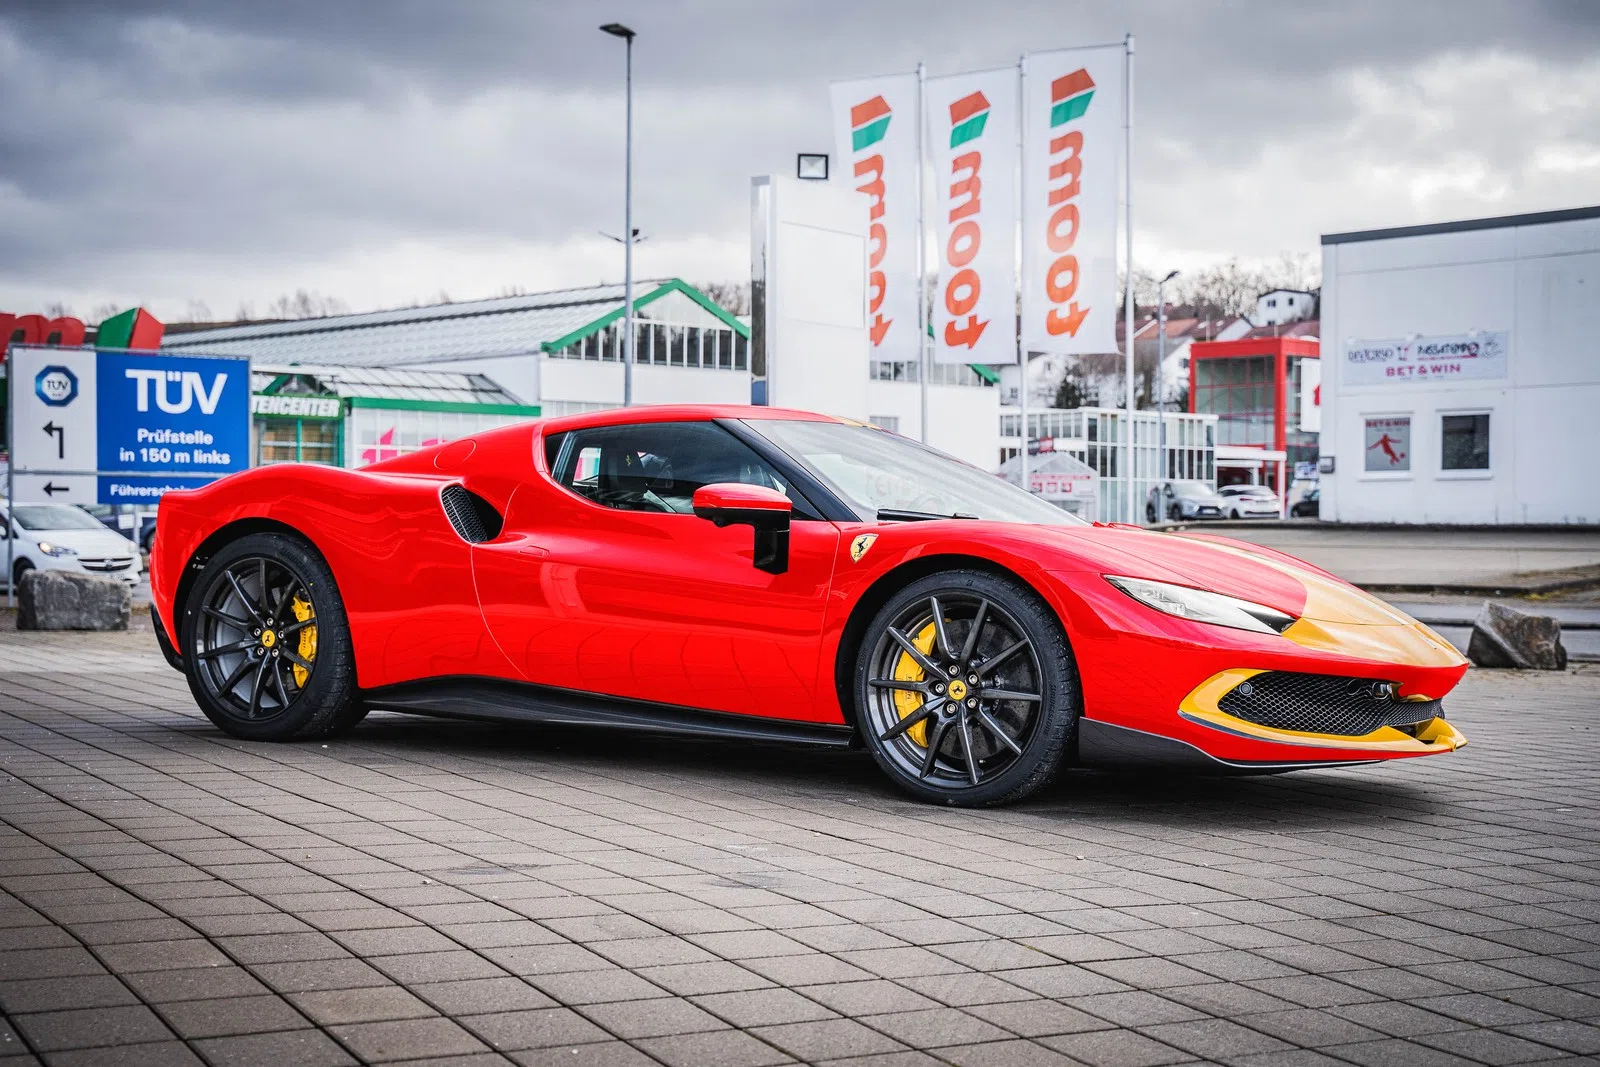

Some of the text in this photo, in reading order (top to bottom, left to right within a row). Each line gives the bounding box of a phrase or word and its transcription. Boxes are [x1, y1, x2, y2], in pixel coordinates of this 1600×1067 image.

[944, 150, 990, 349] toom
[1045, 130, 1090, 338] toom
[125, 368, 228, 415] TÜV
[120, 447, 231, 465] in 150 m links
[137, 428, 214, 445] Prüfstelle
